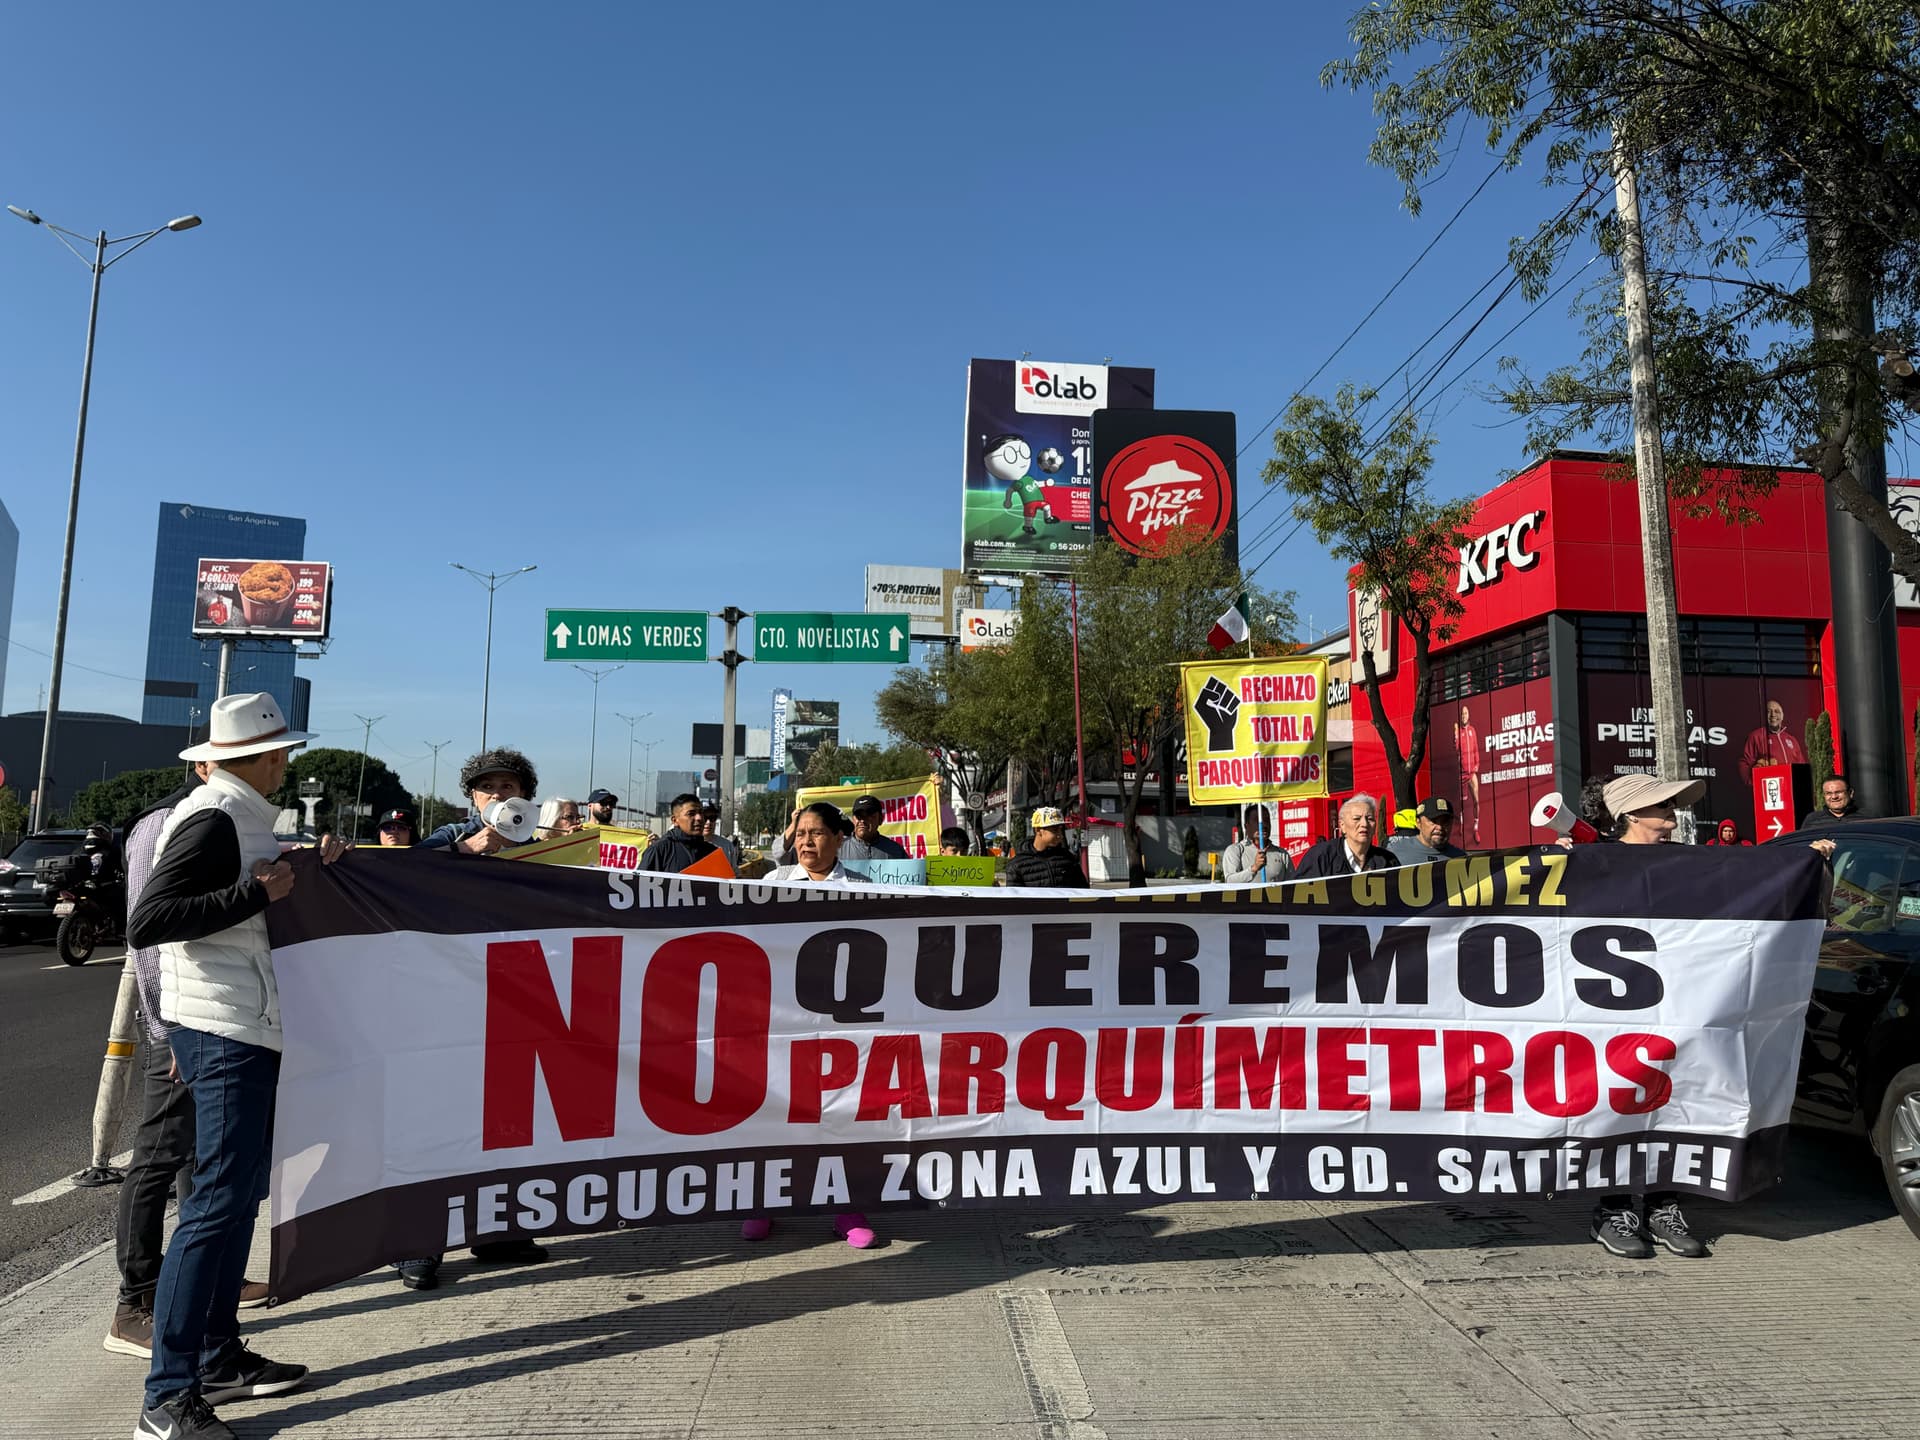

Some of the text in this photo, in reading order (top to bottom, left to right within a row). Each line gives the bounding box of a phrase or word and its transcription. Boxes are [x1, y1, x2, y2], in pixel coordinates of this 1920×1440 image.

[1035, 374, 1097, 400] olab
[1127, 487, 1204, 523] Pizza
[1140, 507, 1194, 535] Hut
[974, 539, 1016, 548] olab.com.mx
[1455, 513, 1540, 594] KFC
[200, 571, 240, 584] 3 GOLAZOS
[211, 565, 230, 573] KFC
[872, 583, 941, 595] +70% PROTEÍNA
[883, 594, 941, 606] 0% LACTOSA
[577, 624, 703, 648] LOMAS VERDES
[760, 627, 880, 650] CTO. NOVELISTAS
[977, 623, 1015, 637] olab
[1240, 674, 1317, 703] RECHAZO
[1251, 716, 1314, 743] TOTAL A
[1485, 723, 1554, 752] PIERNAS
[1598, 723, 1728, 745] PIERAS
[1198, 753, 1321, 788] PARQUÍMETROS
[927, 859, 984, 881] Exigimos
[608, 873, 706, 910] SRA.
[795, 921, 1665, 1023] QUEREMOS
[482, 931, 771, 1151] NO
[788, 1014, 1676, 1124] PARQUÍMETROS
[446, 1141, 1733, 1247] ¡ESCUCHE A ZONA AZUL Y CD. SATÉLITE!
